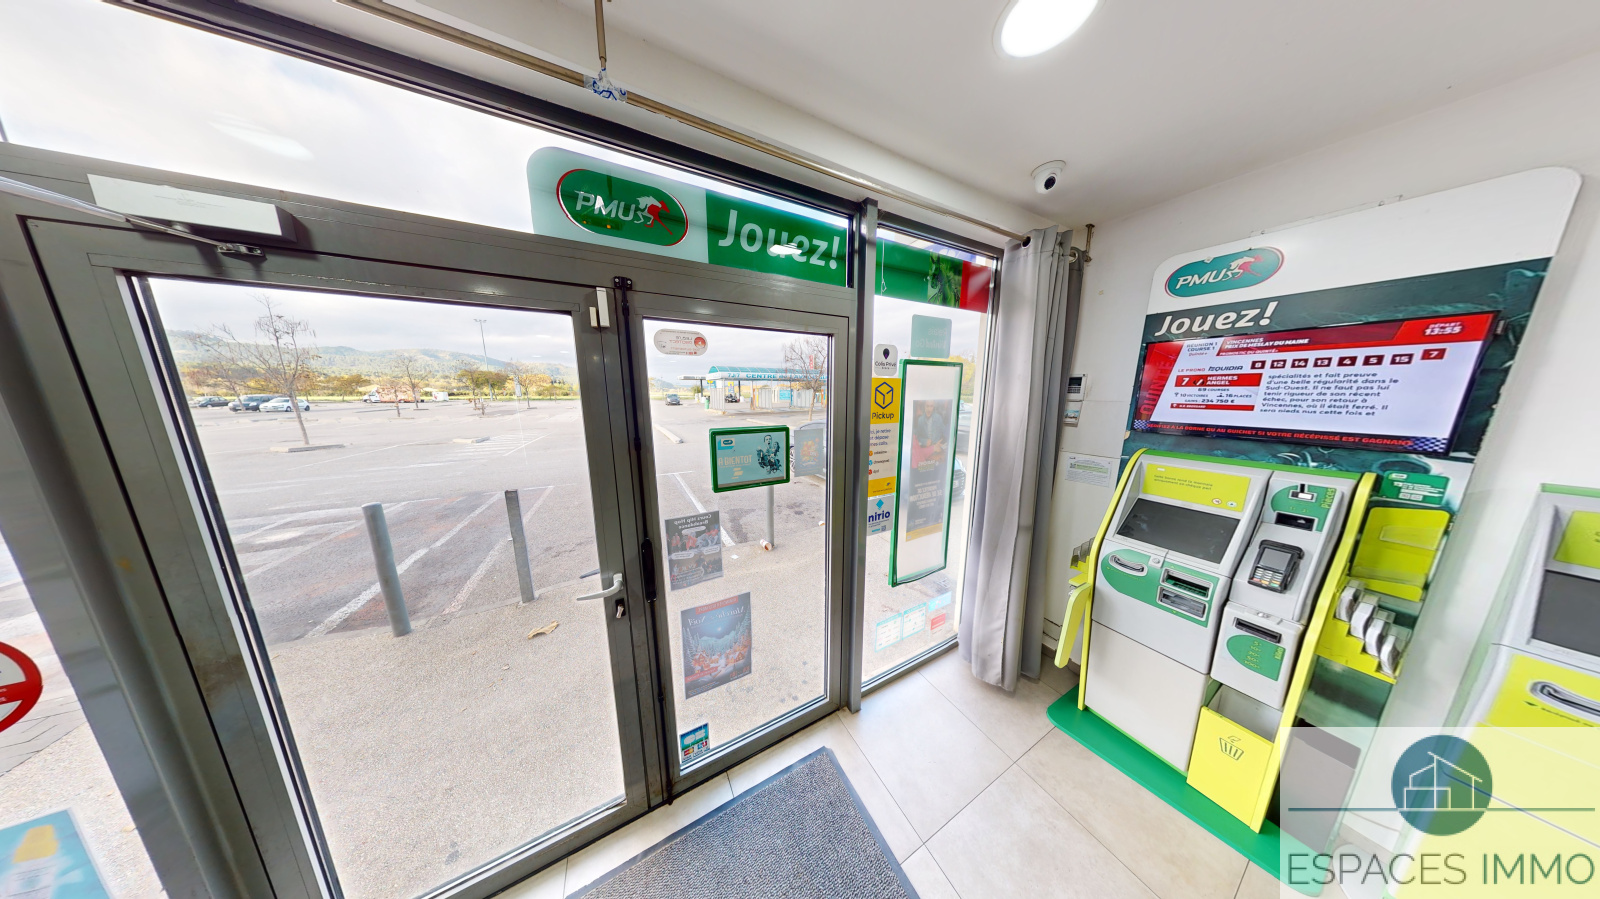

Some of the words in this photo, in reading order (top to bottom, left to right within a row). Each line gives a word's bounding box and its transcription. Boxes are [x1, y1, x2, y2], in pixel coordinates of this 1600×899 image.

[574, 190, 636, 220] PMU
[718, 209, 840, 270] Jouez!
[1176, 268, 1227, 289] PMU
[1154, 301, 1279, 336] Jouez!
[1293, 432, 1340, 440] RÉCÉPISSÉ
[868, 510, 890, 522] nirio
